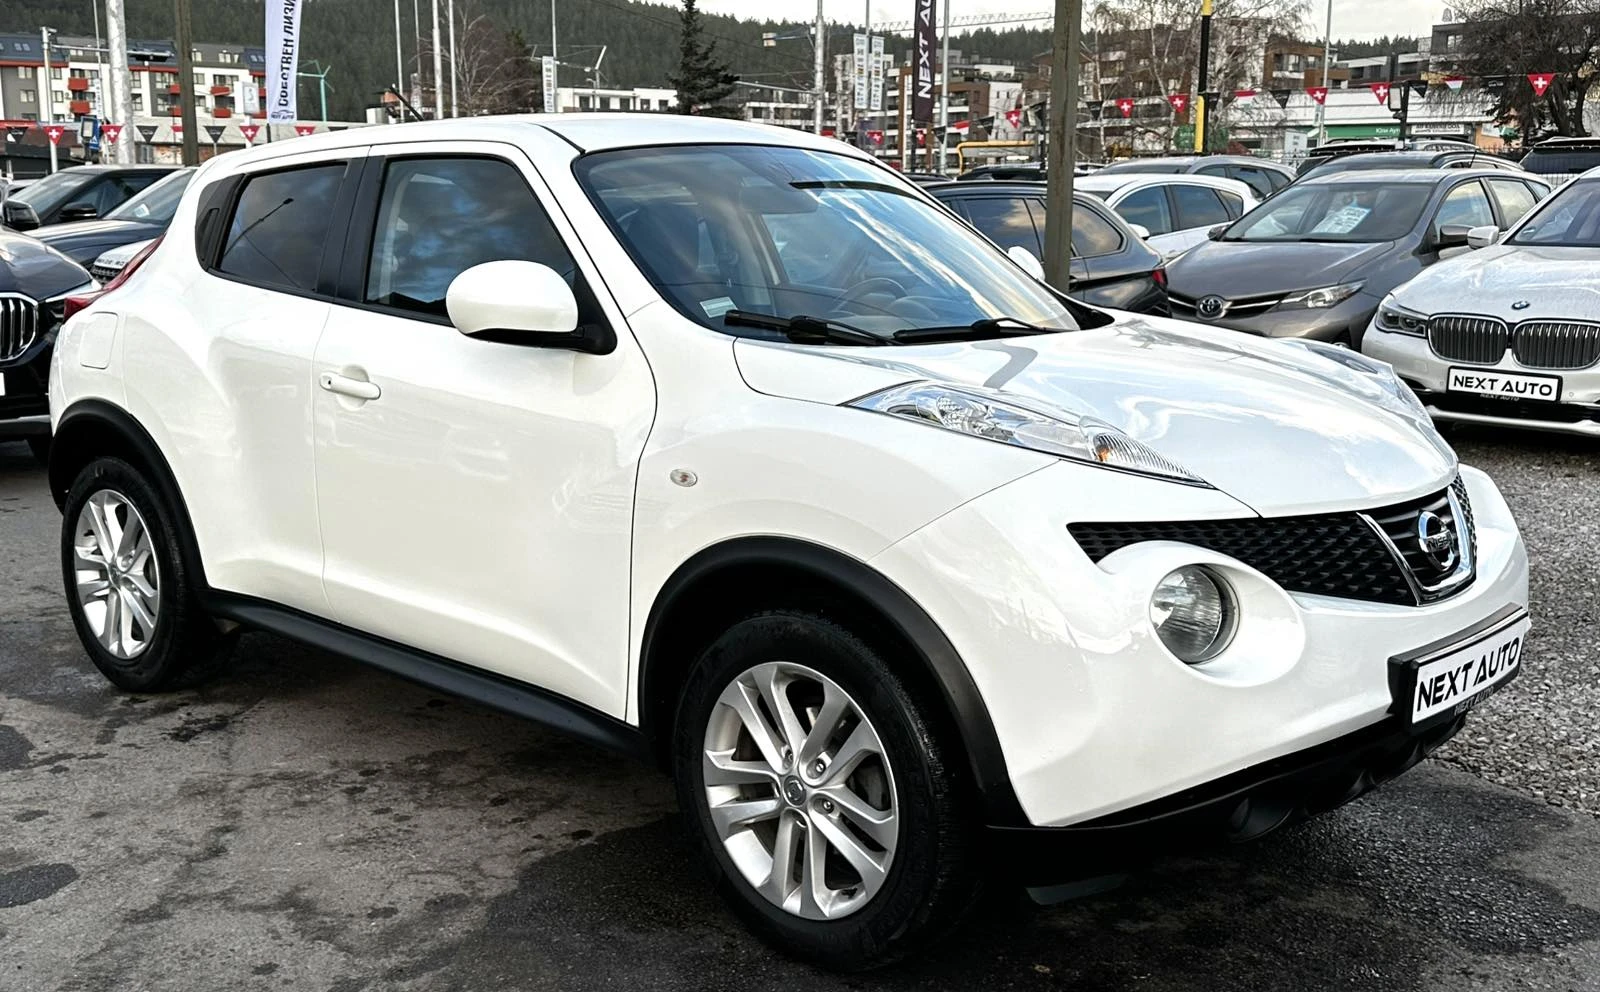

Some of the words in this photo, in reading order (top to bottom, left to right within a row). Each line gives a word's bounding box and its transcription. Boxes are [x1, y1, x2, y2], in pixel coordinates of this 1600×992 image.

[918, 31, 932, 99] NEXT
[1453, 374, 1498, 391] NEXT
[1501, 380, 1553, 397] AUTO
[1417, 659, 1475, 712] NEXT
[1473, 636, 1519, 687] AUTO
